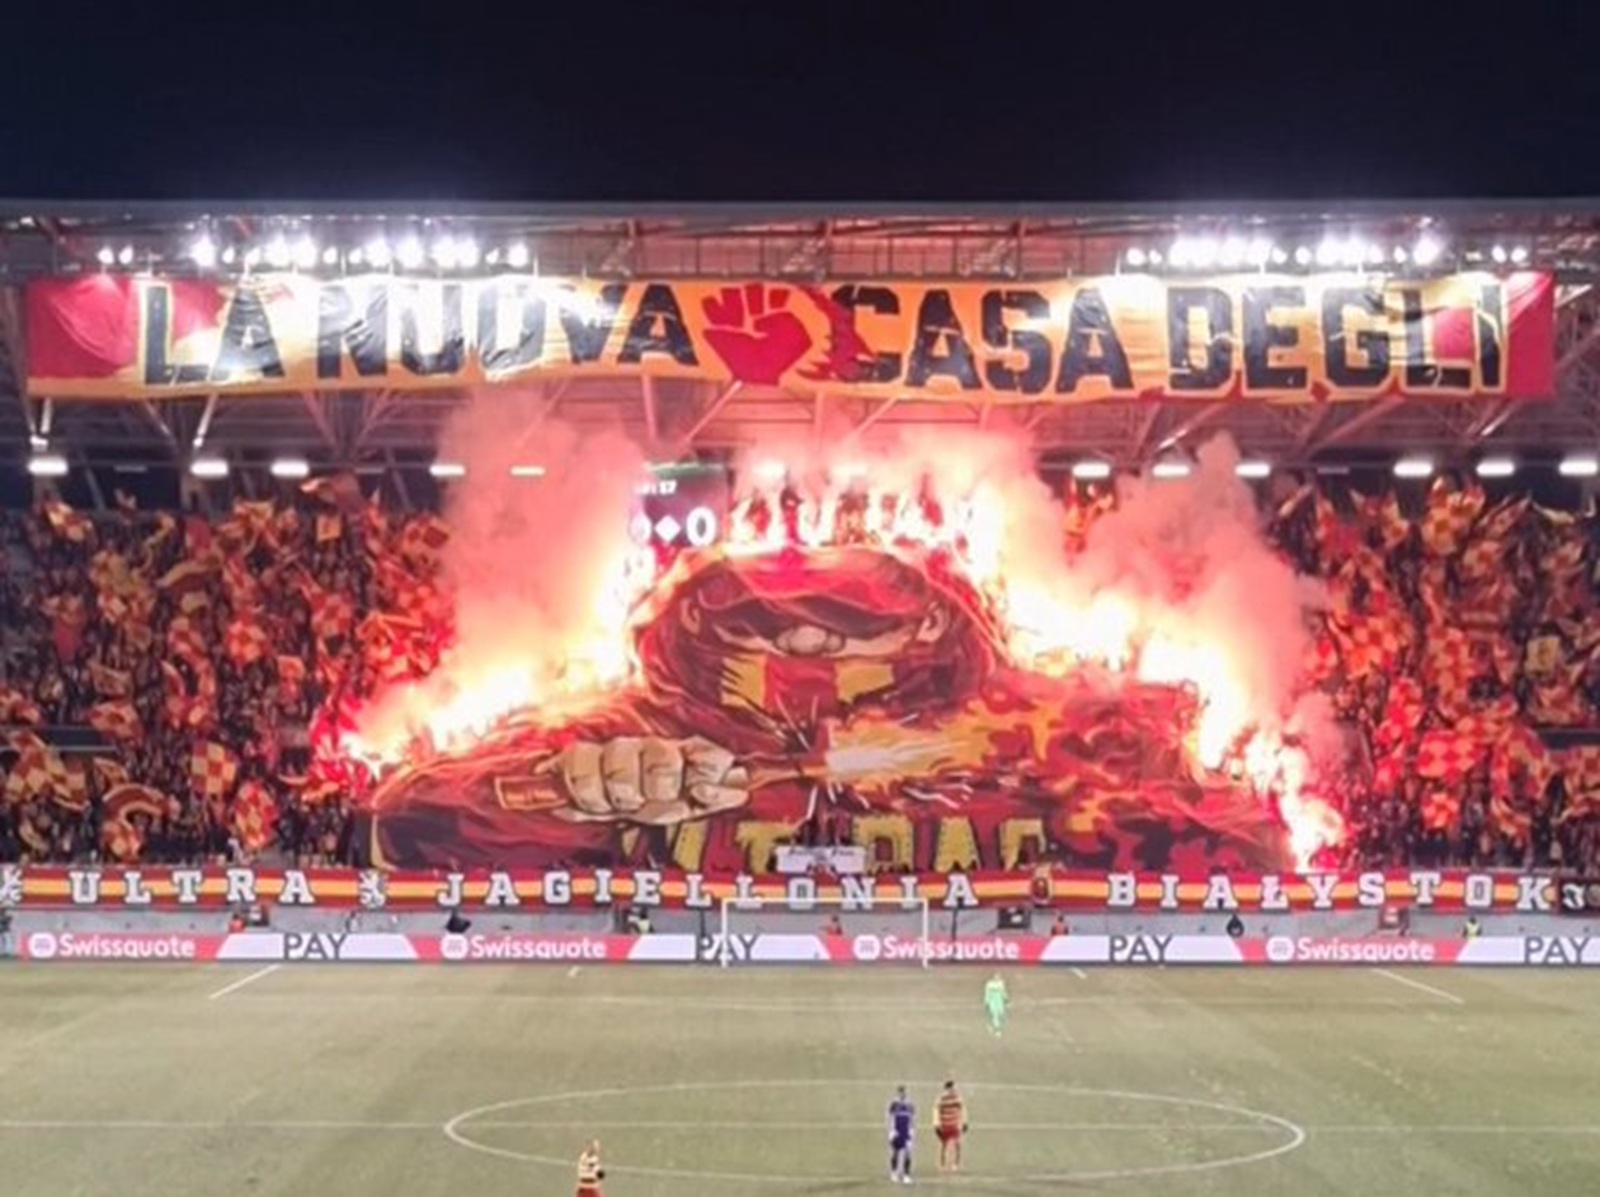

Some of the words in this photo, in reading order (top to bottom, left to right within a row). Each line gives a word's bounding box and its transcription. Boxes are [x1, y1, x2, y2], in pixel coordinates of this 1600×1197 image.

[143, 281, 286, 384] LA
[316, 282, 699, 378] NUOVA
[830, 284, 1136, 393] CASA
[1166, 284, 1504, 390] DEGLI
[686, 506, 717, 547] 0
[70, 869, 315, 905] ULTRA
[437, 870, 977, 910] JAGIELLONIA
[1107, 872, 1552, 909] BIAŁYSTOK
[60, 934, 195, 958] Swissquote
[283, 933, 348, 960] PAY
[470, 935, 607, 959] Swissquote
[883, 935, 1020, 960] Swissquote
[1109, 936, 1172, 963] PAY
[1298, 937, 1436, 962] Swissquote
[1525, 936, 1591, 963] PAY
